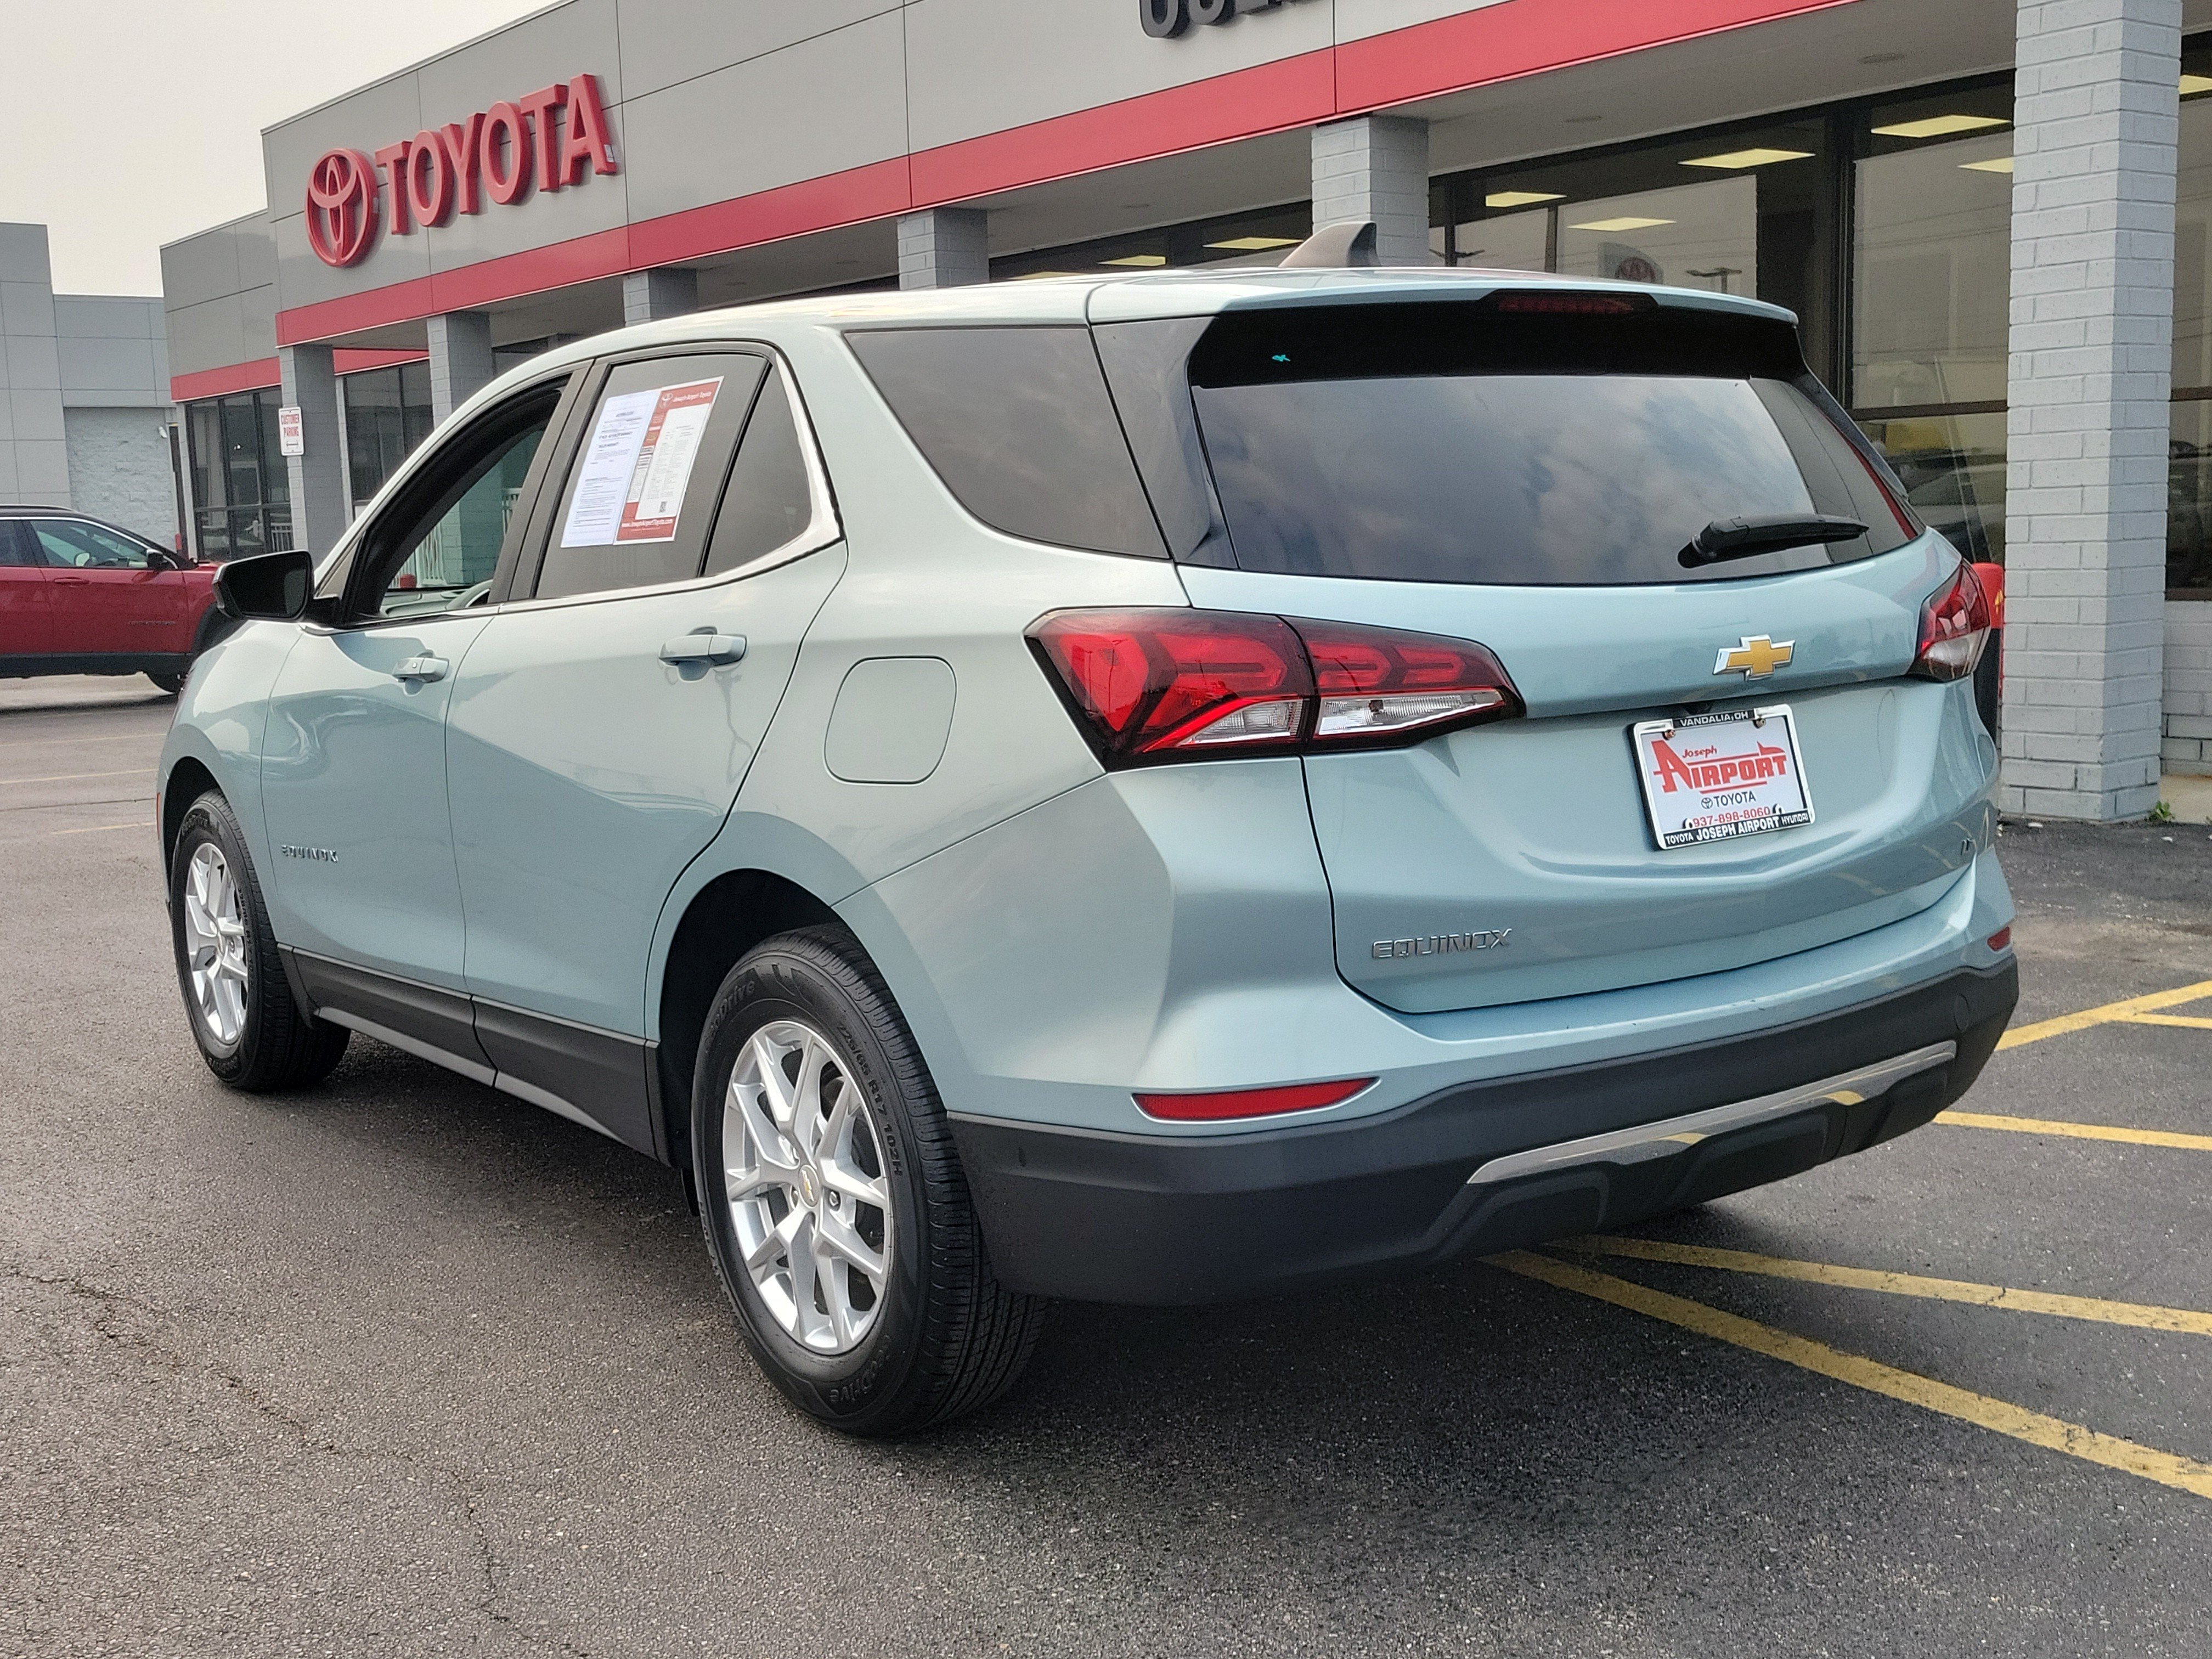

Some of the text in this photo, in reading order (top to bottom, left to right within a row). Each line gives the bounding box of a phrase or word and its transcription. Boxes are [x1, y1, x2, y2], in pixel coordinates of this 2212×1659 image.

[374, 73, 617, 235] TOYOTA
[281, 413, 300, 425] CUSTOMER
[284, 426, 299, 437] PARKING
[1682, 745, 1718, 758] Joseph
[1651, 740, 1787, 793] AIRPORT
[1713, 792, 1756, 808] TOYOTA
[1692, 806, 1771, 827] 937-898-8060
[1665, 811, 1809, 846] TOYOTA JOSEPH AIRPORT HYUNDAI
[281, 845, 338, 863] EQUINOX
[1372, 928, 1513, 959] EQUINOX
[868, 1079, 887, 1116] R17
[883, 1124, 903, 1177] 102H
